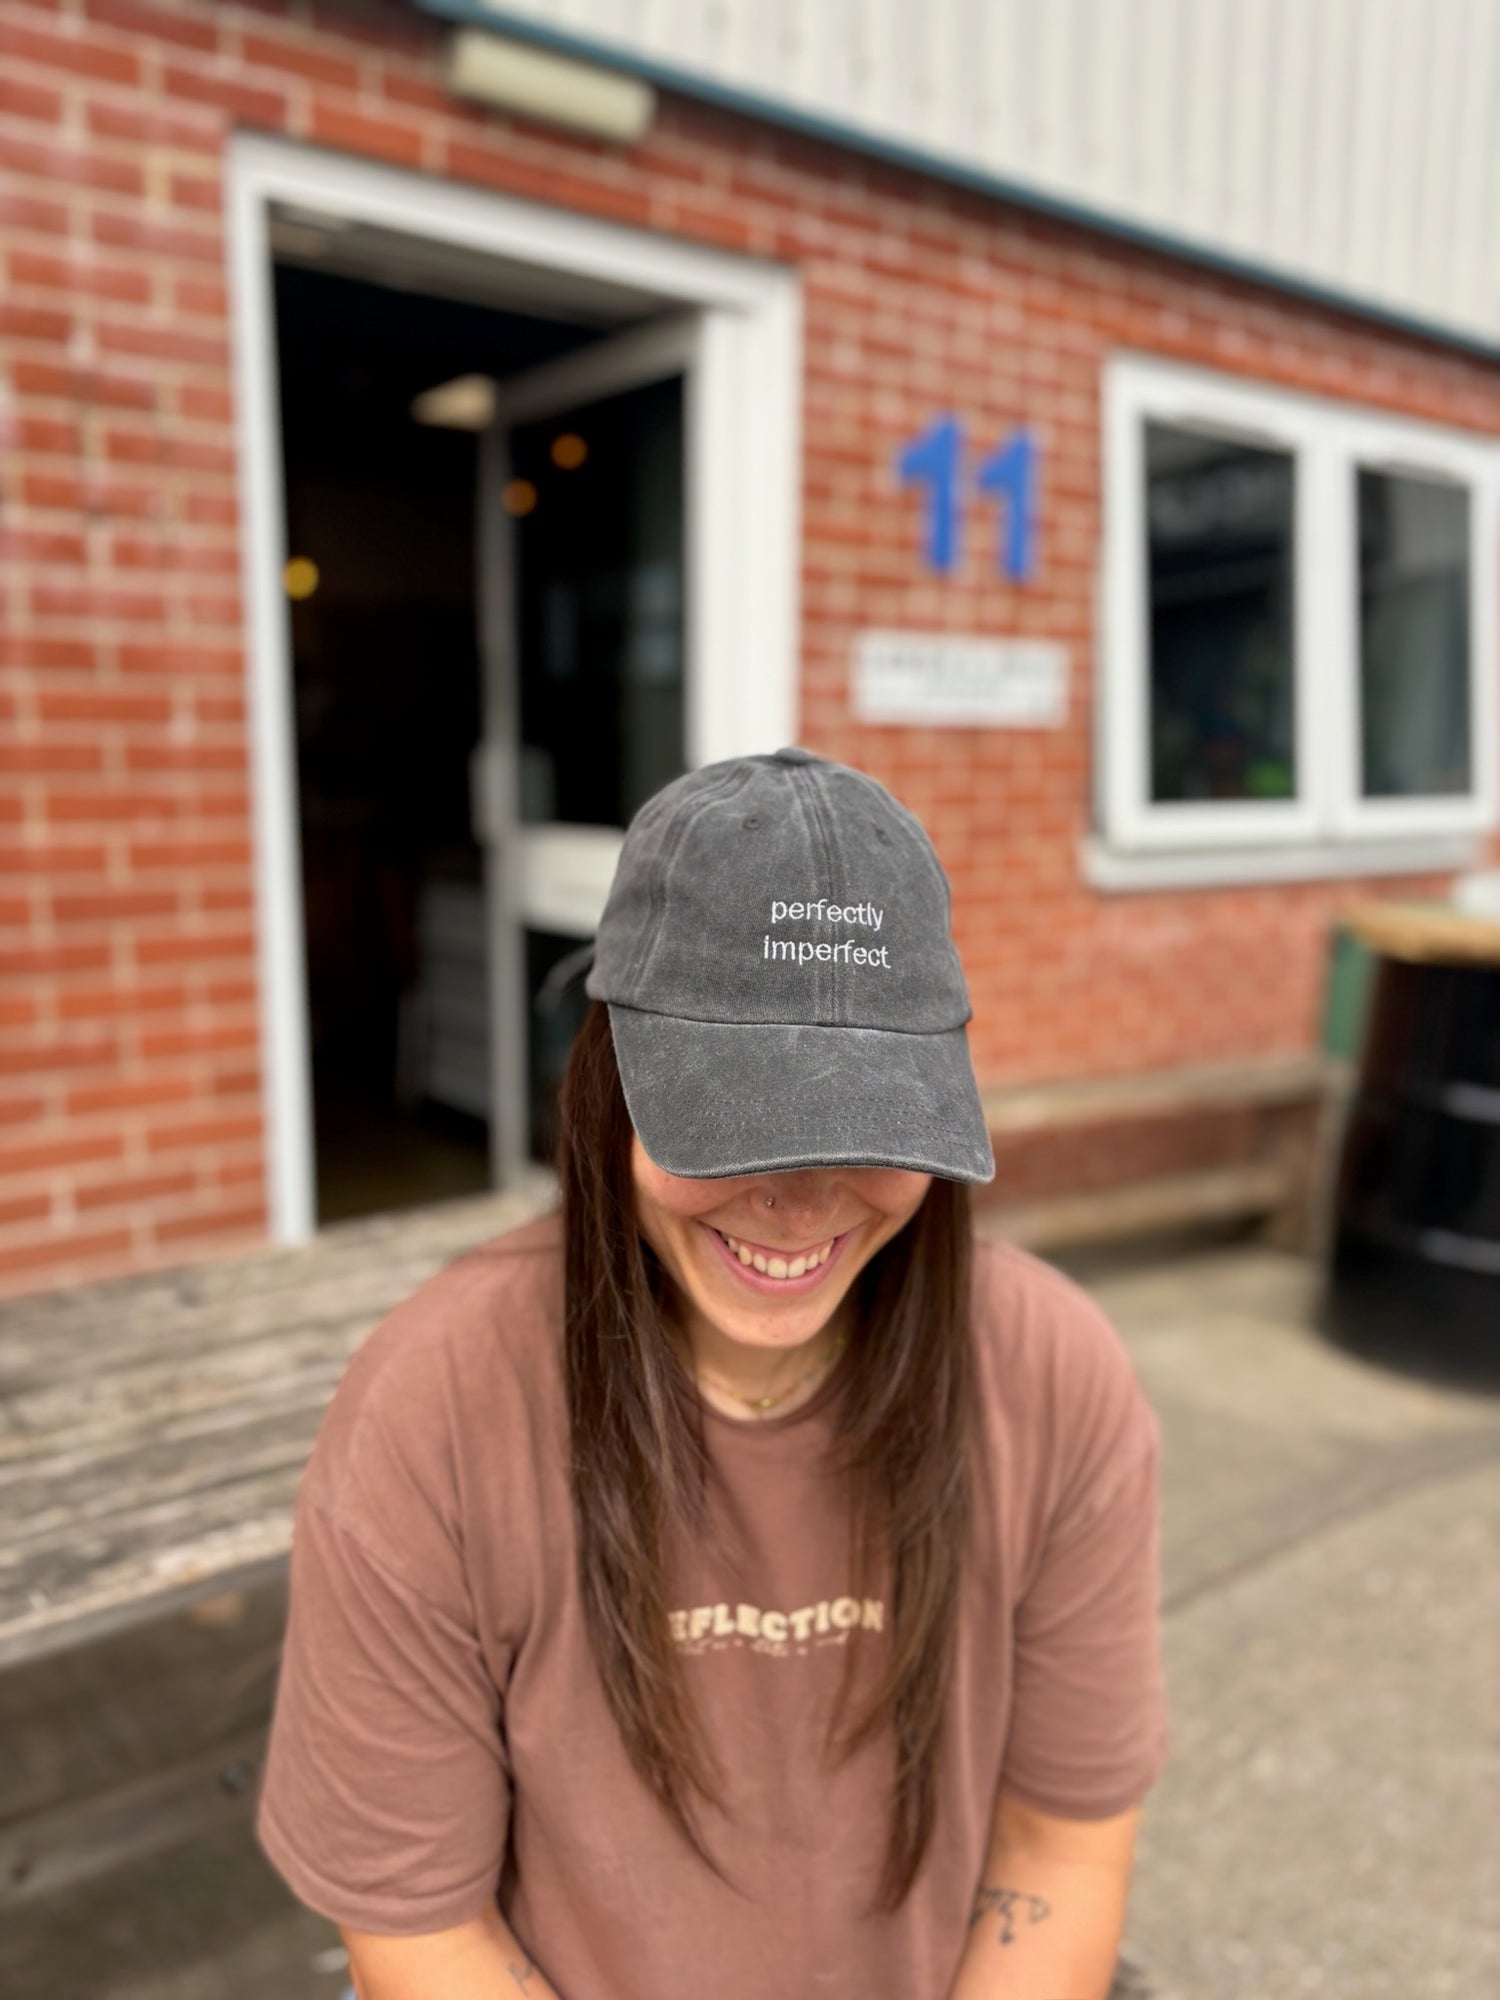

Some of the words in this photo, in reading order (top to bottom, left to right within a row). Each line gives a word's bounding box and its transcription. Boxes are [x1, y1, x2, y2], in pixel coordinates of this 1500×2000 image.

[897, 413, 1038, 583] 11
[771, 898, 884, 931] perfectly
[763, 934, 891, 969] imperfect
[667, 1597, 884, 1641] EFLECTION
